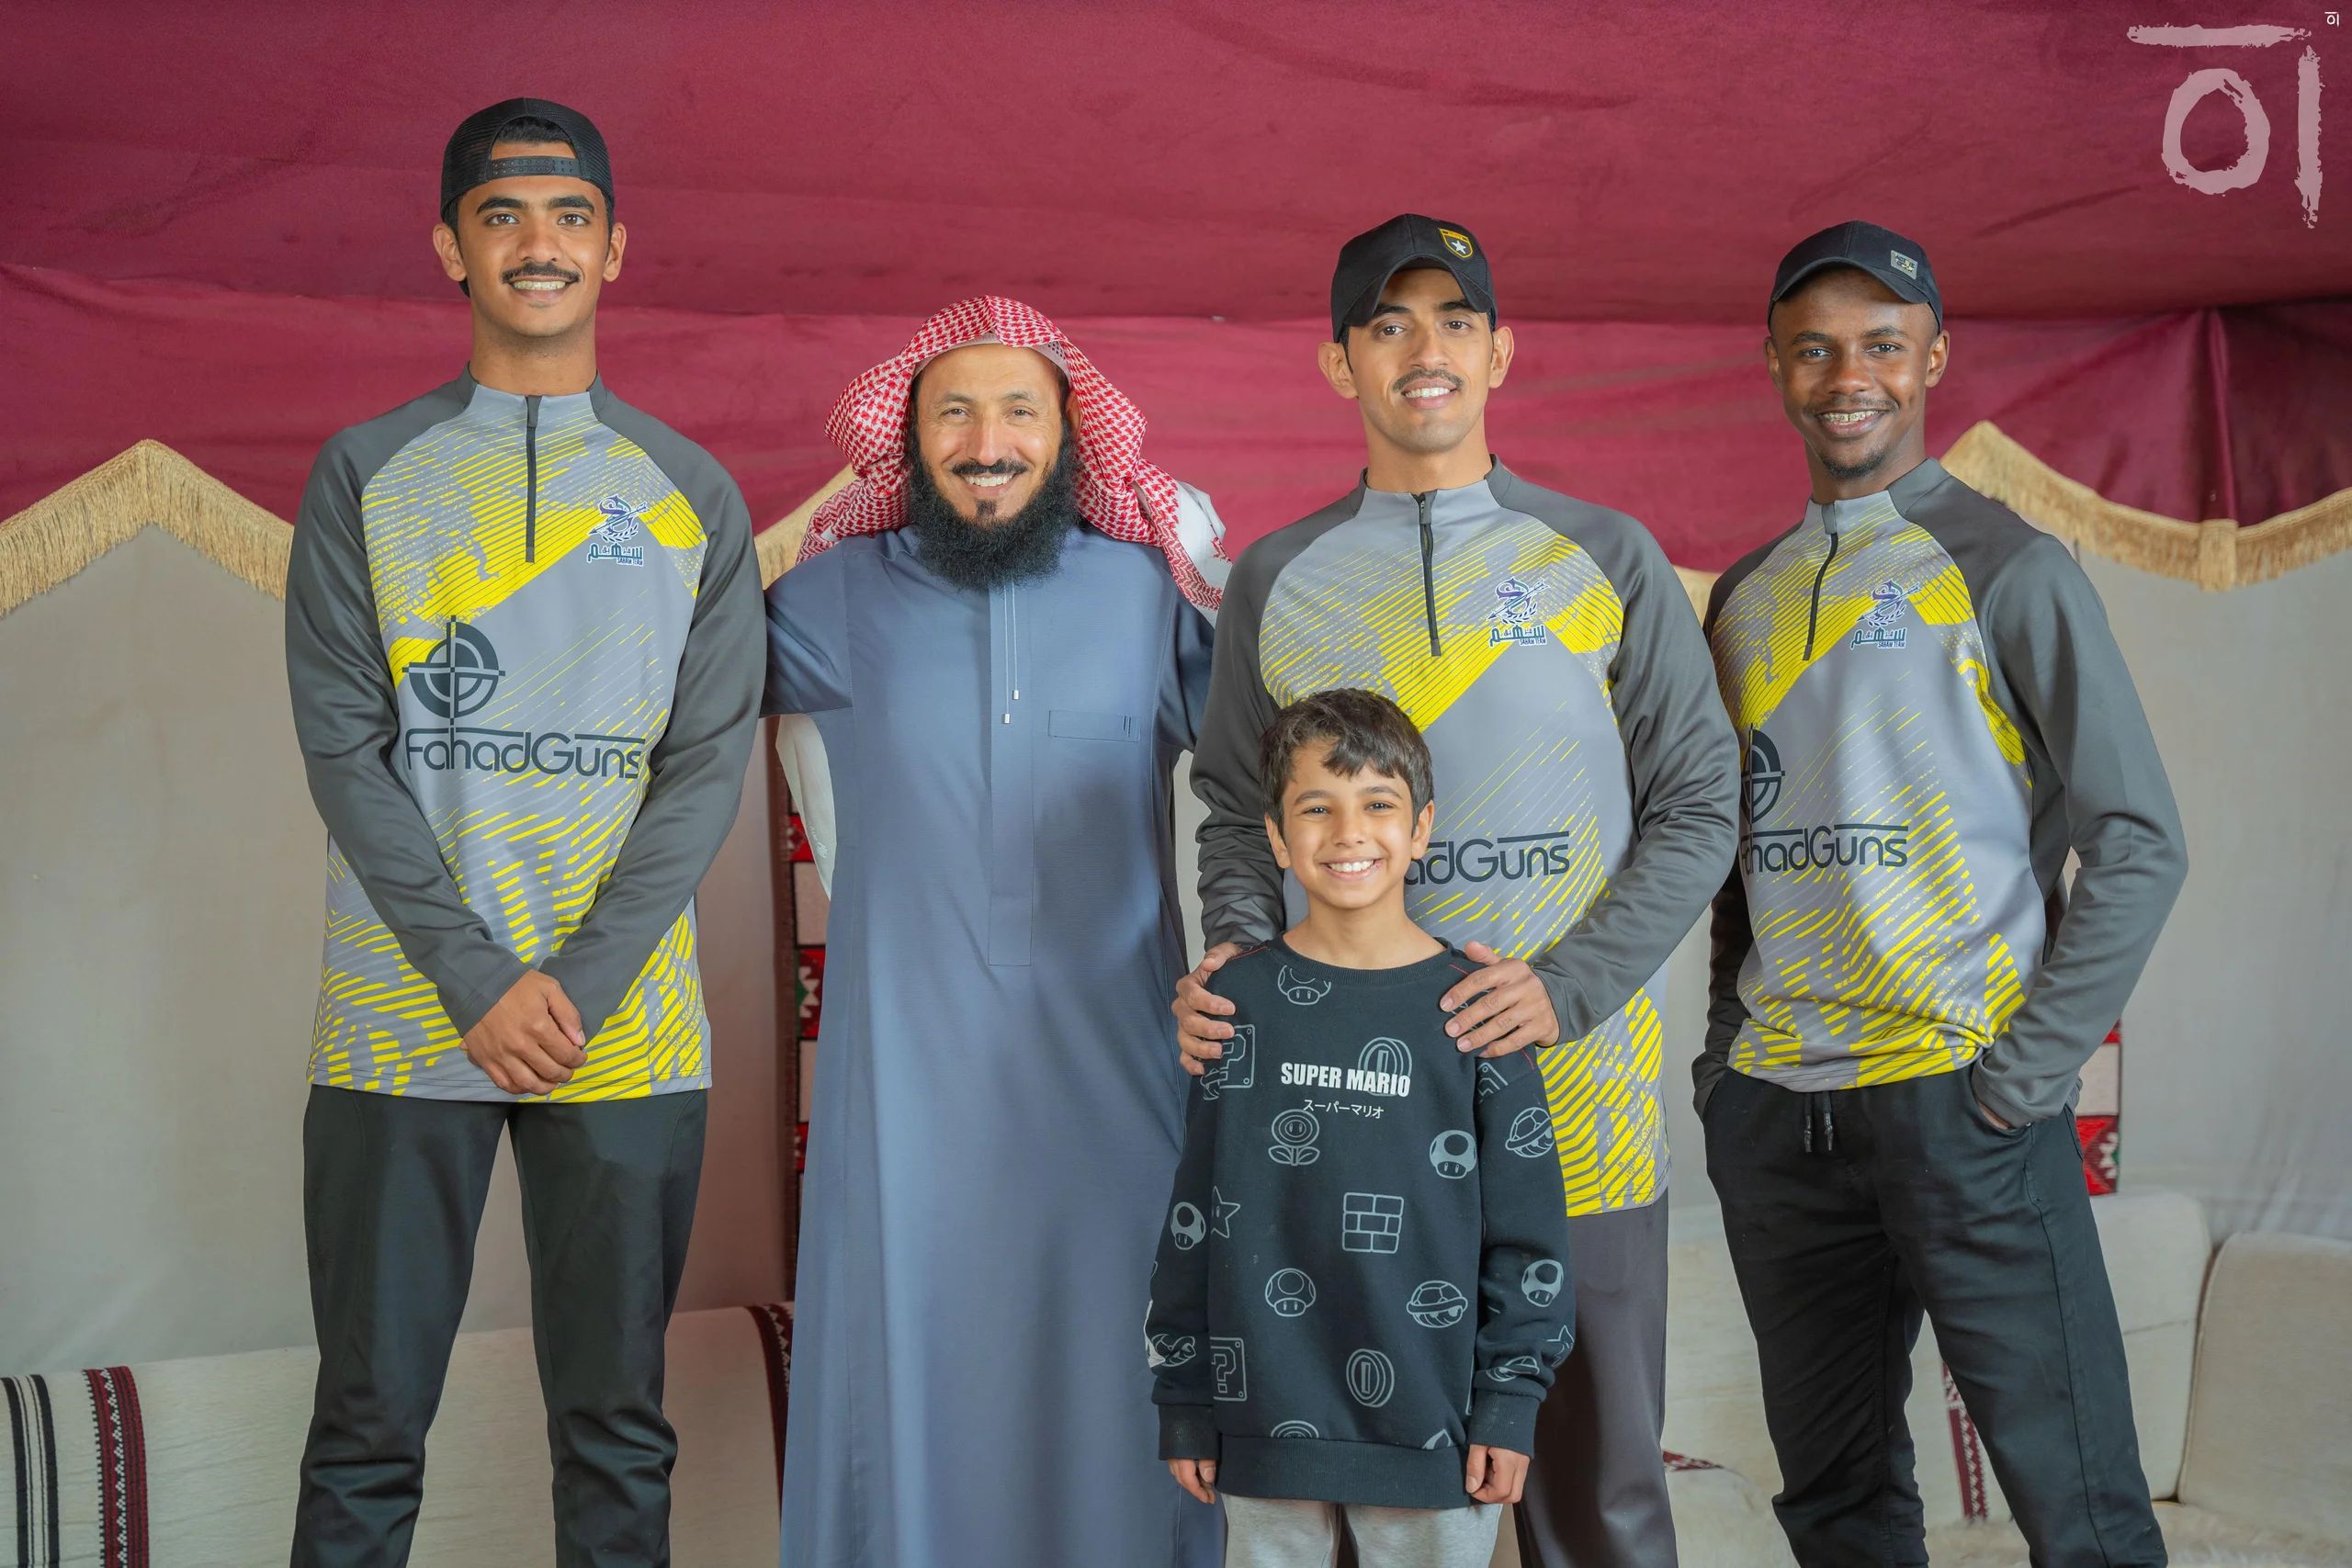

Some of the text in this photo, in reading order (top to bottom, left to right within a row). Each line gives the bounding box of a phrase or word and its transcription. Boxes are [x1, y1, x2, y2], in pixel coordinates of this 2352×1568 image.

[405, 727, 646, 779] FahadGuns
[1405, 830, 1570, 885] adGuns
[1281, 1062, 1411, 1098] SUPER MARIO
[1303, 1100, 1385, 1119] スーパーマリオ
